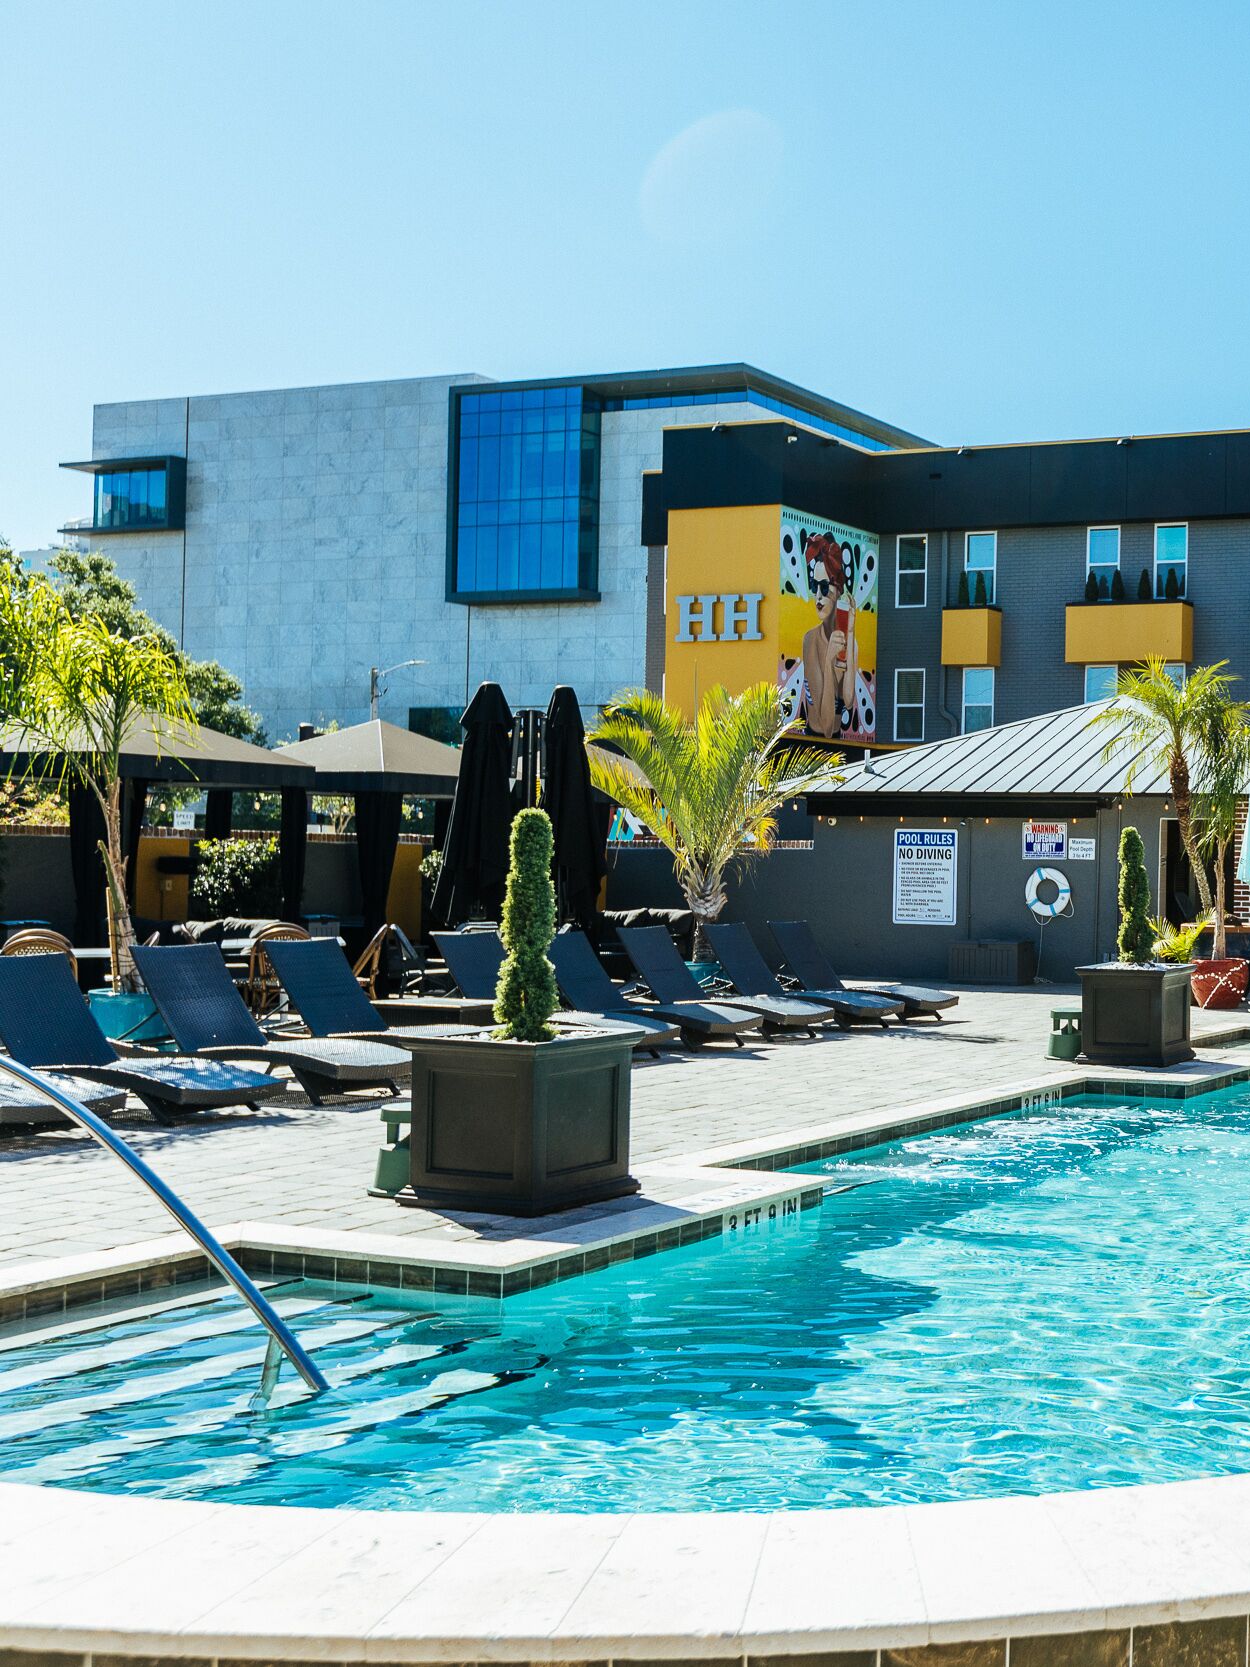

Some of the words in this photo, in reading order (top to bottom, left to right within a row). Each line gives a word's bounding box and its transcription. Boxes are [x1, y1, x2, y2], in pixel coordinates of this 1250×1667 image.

[675, 593, 764, 642] HH
[1032, 824, 1058, 834] WARNING
[898, 834, 922, 844] POOL
[924, 834, 953, 845] RULES
[1026, 834, 1034, 843] NO
[1035, 834, 1062, 843] LIFEGUARD
[1033, 842, 1040, 852] ON
[1042, 842, 1056, 852] DUTY
[898, 848, 914, 860] NO
[916, 848, 952, 860] DIVING
[1033, 1094, 1042, 1108] FT
[1052, 1090, 1060, 1102] IN
[745, 1207, 762, 1228] FT
[782, 1198, 798, 1216] IN
